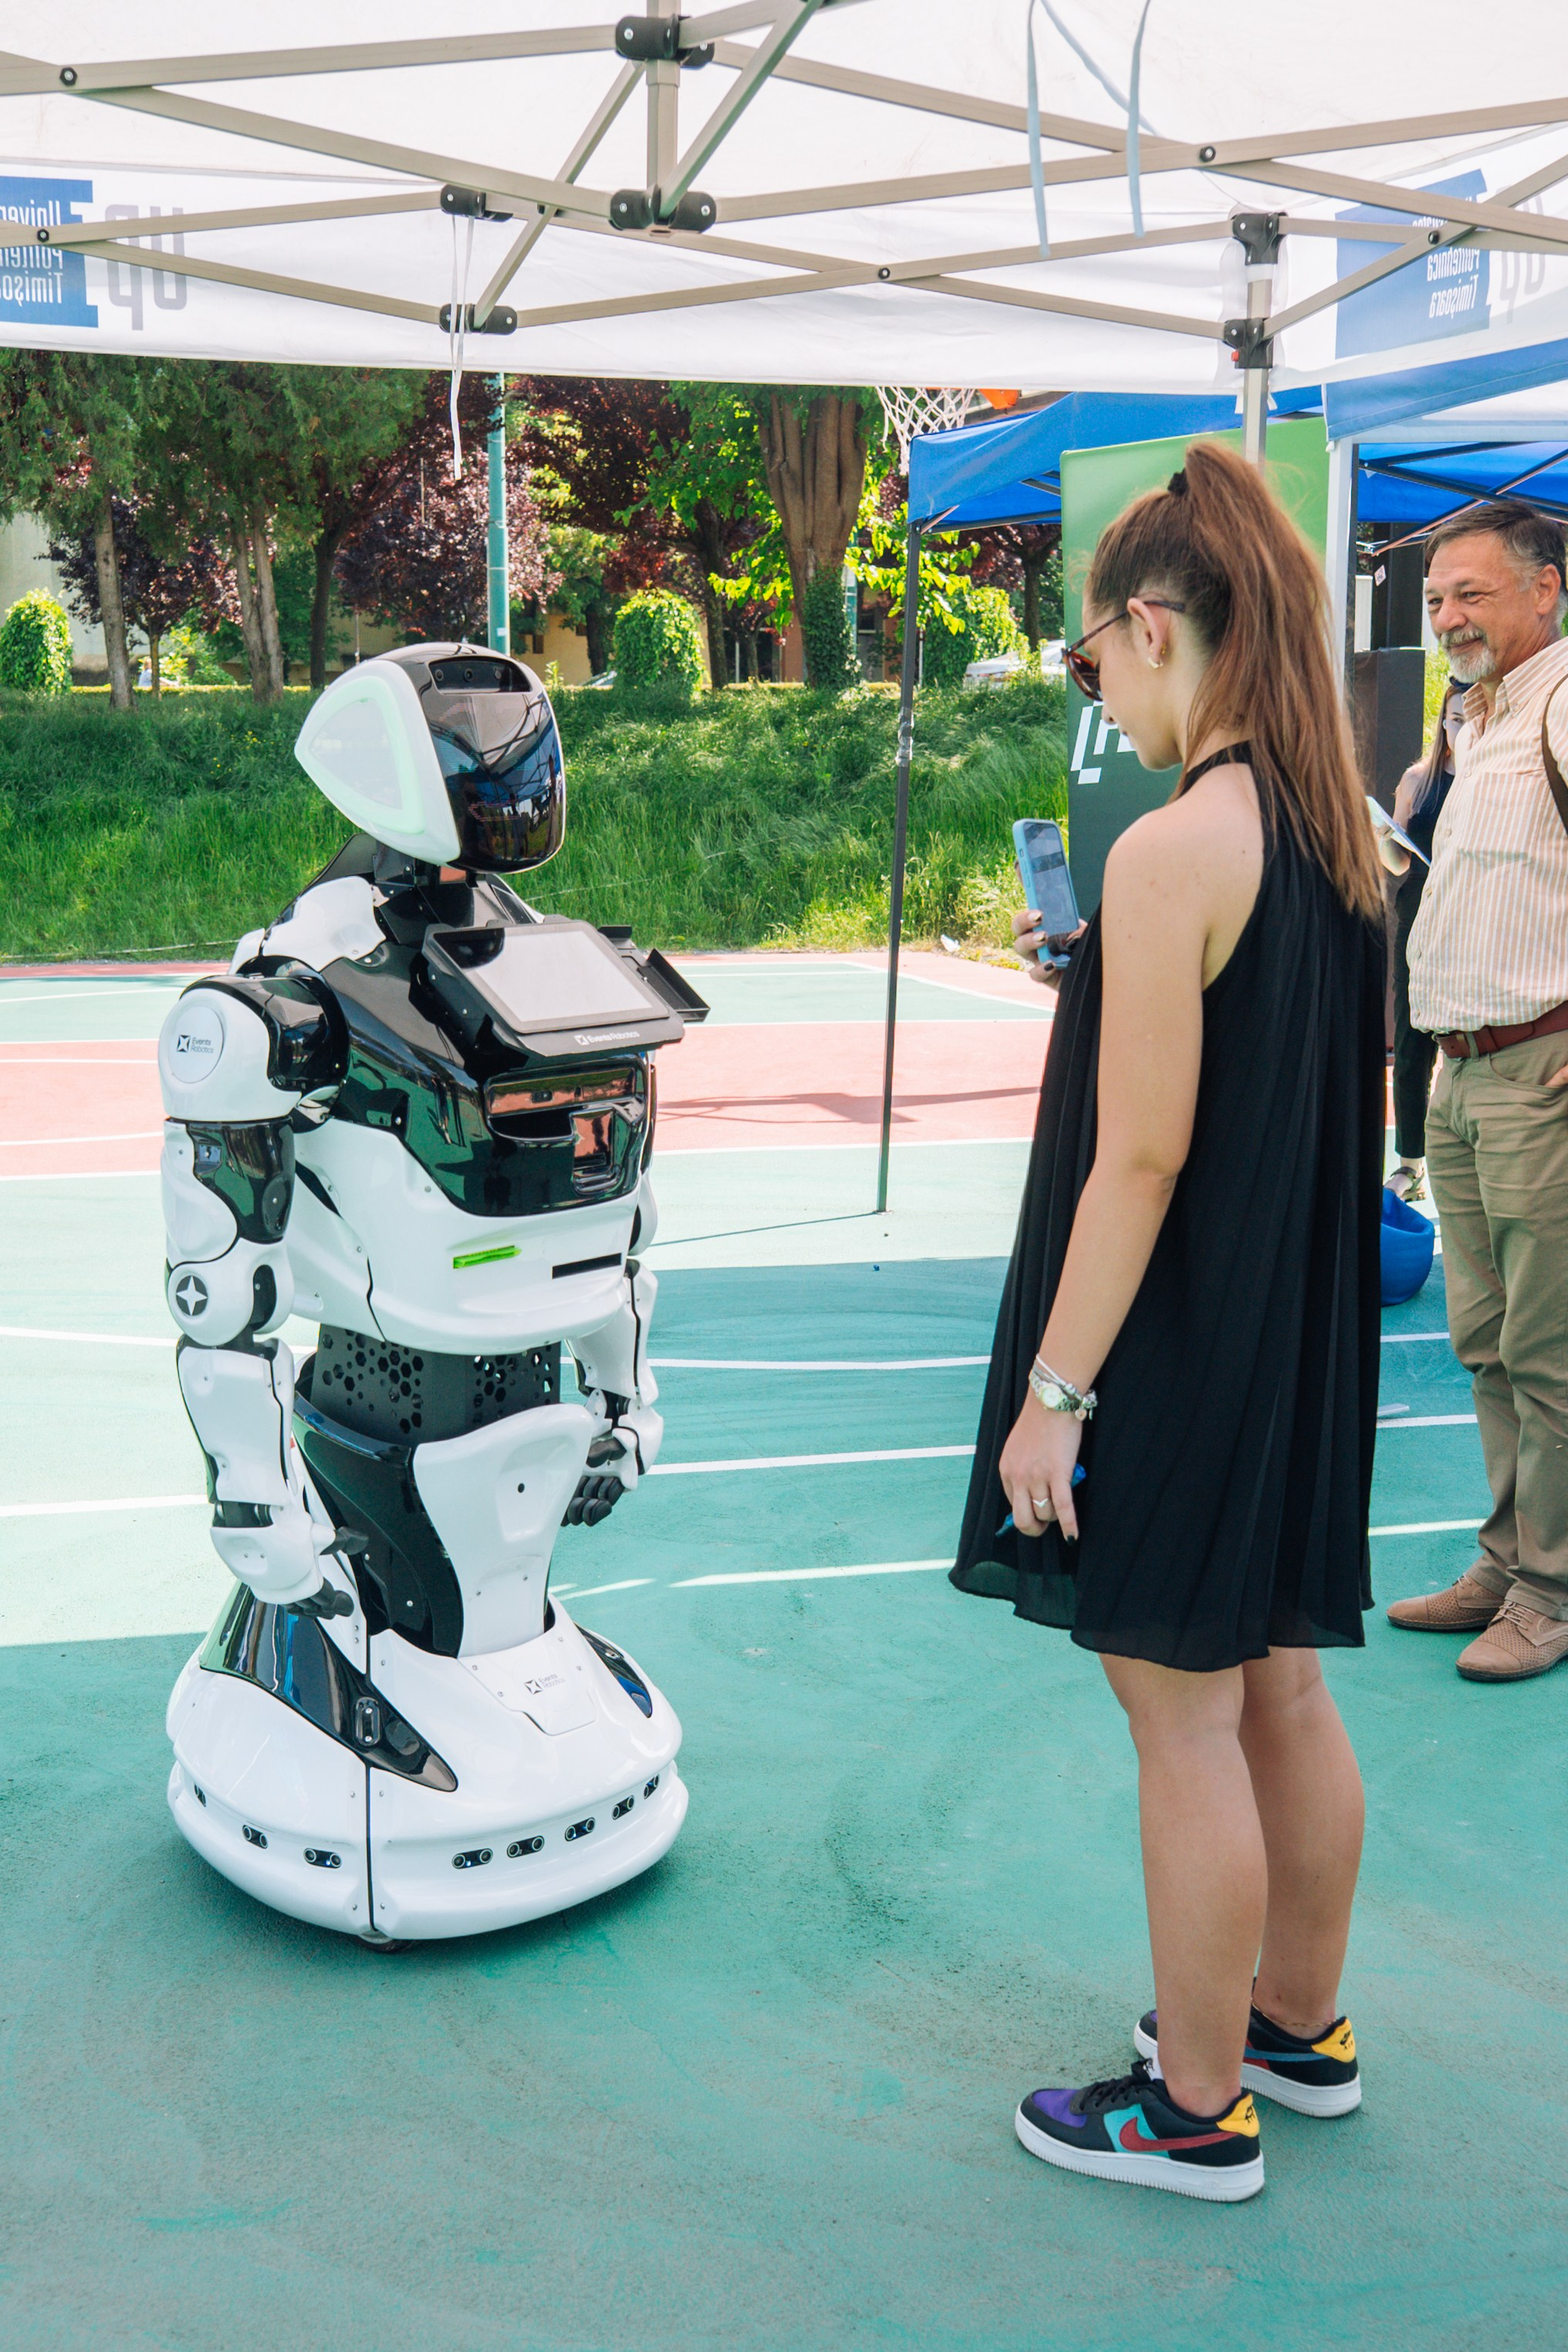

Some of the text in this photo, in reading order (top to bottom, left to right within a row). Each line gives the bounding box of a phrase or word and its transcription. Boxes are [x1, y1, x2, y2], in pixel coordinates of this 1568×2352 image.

[191, 1037, 211, 1046] Events
[586, 1031, 640, 1043] Events Robotics
[191, 1045, 214, 1054] Robotics
